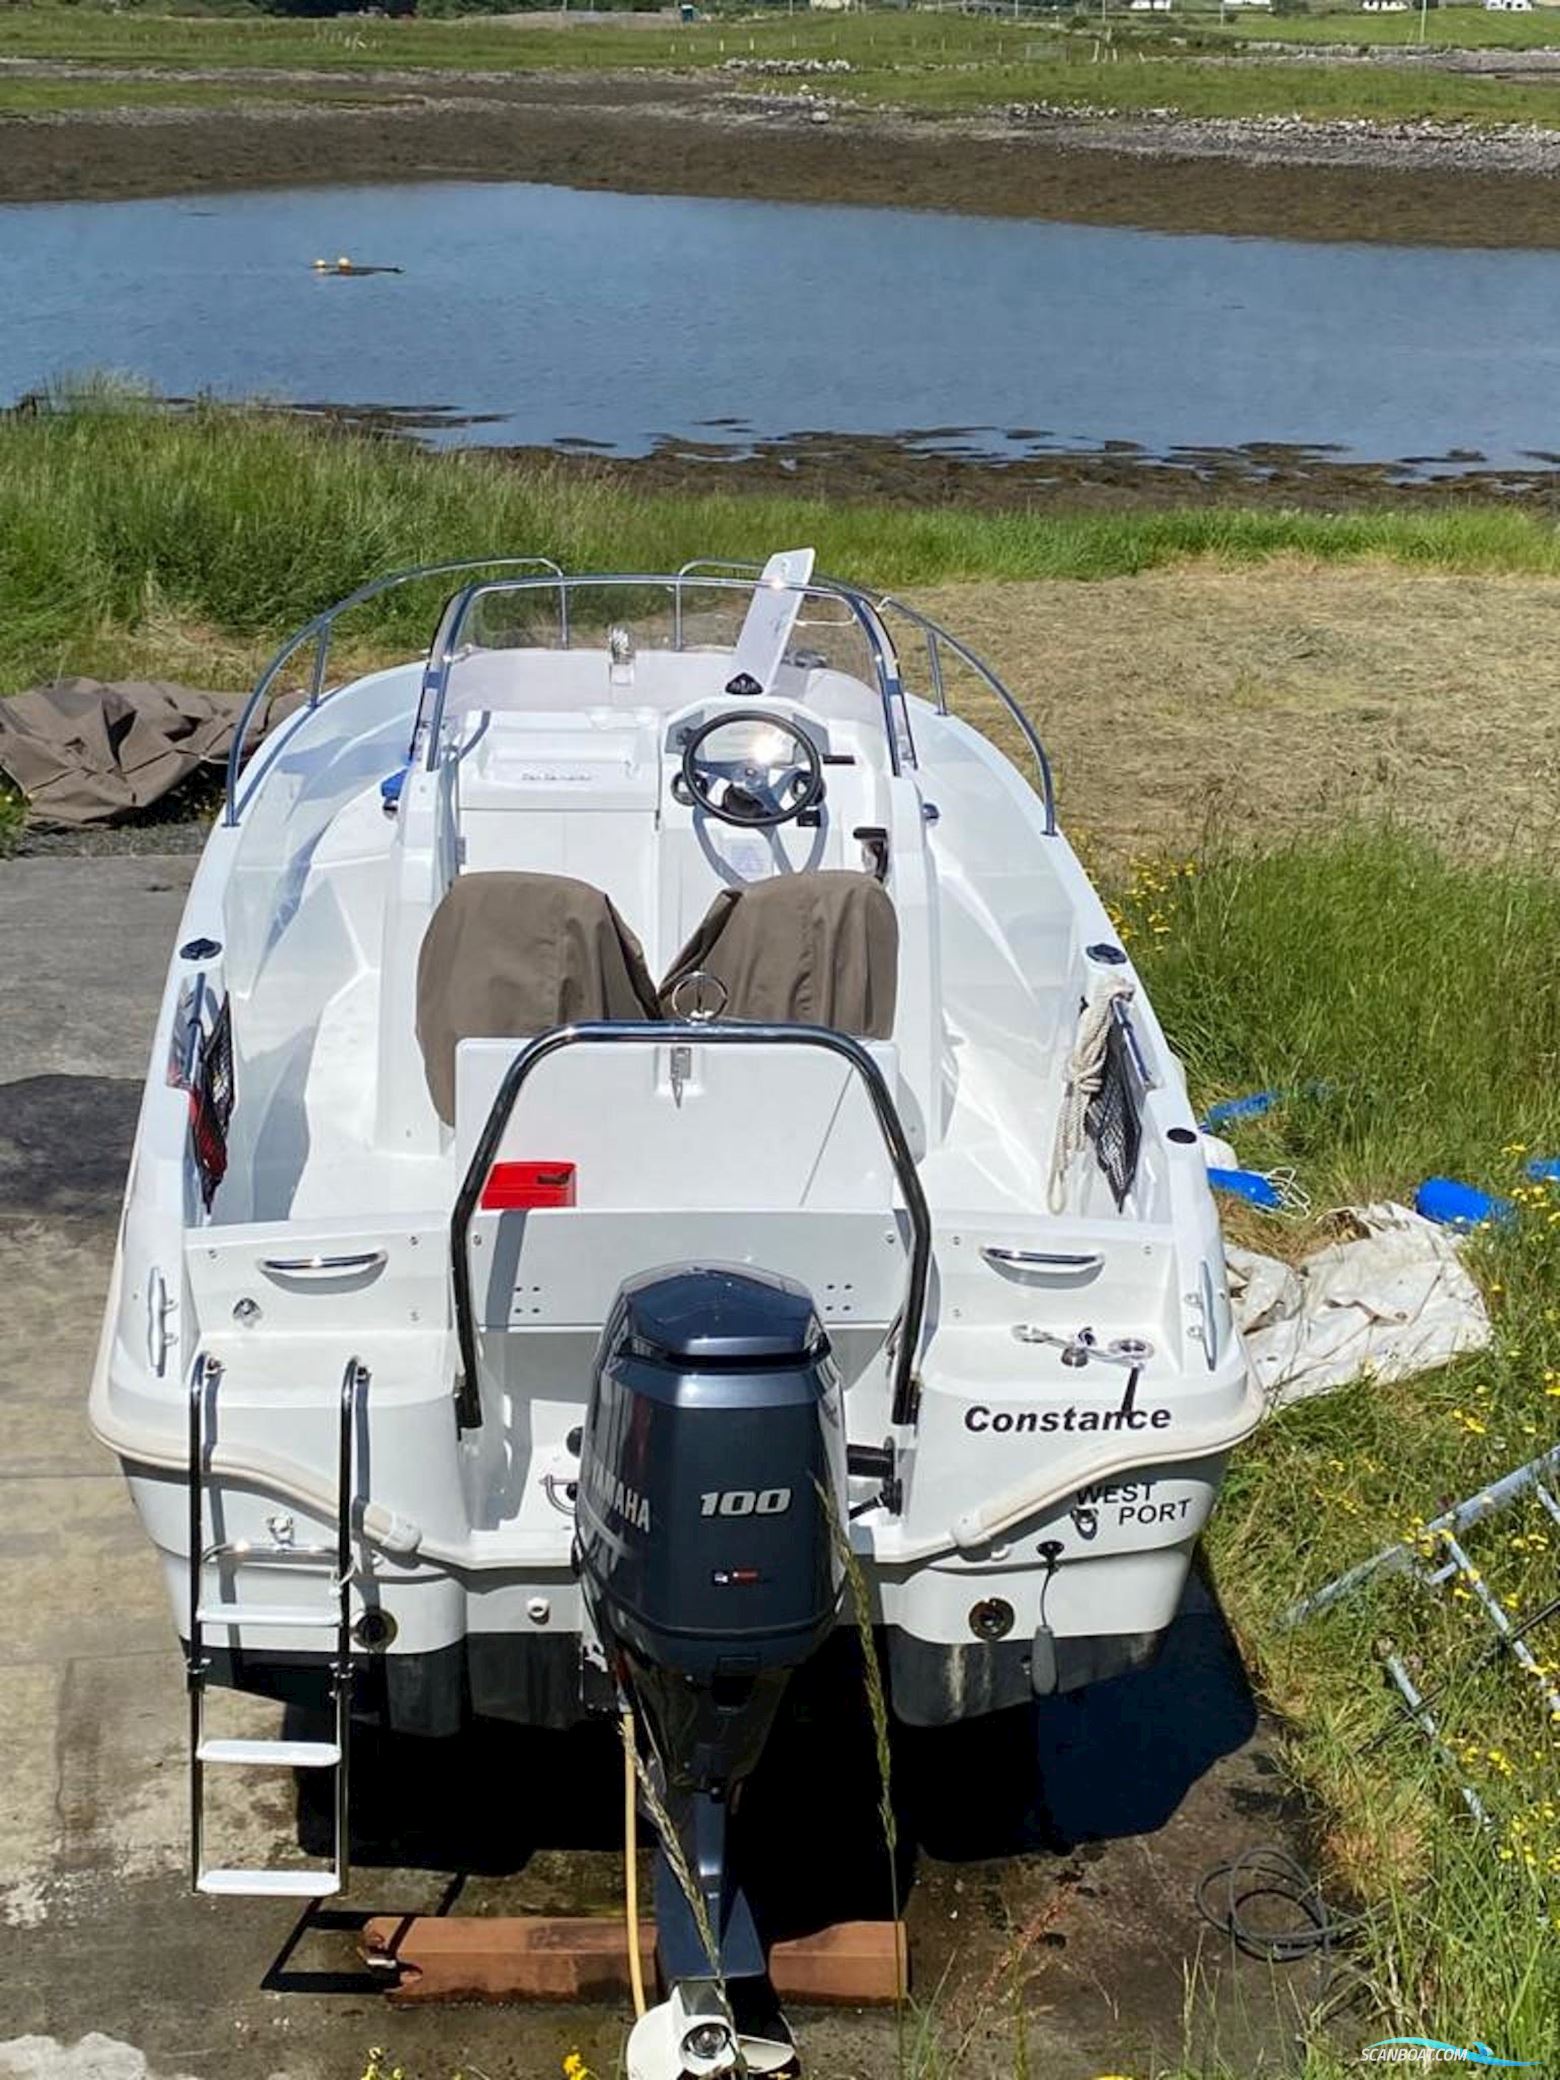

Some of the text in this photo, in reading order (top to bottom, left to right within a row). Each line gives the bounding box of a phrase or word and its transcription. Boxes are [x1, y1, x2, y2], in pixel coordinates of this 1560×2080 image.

[964, 1405, 1171, 1432] Constance
[700, 1488, 791, 1516] 100
[1077, 1482, 1156, 1504] WEST
[1118, 1498, 1191, 1525] PORT
